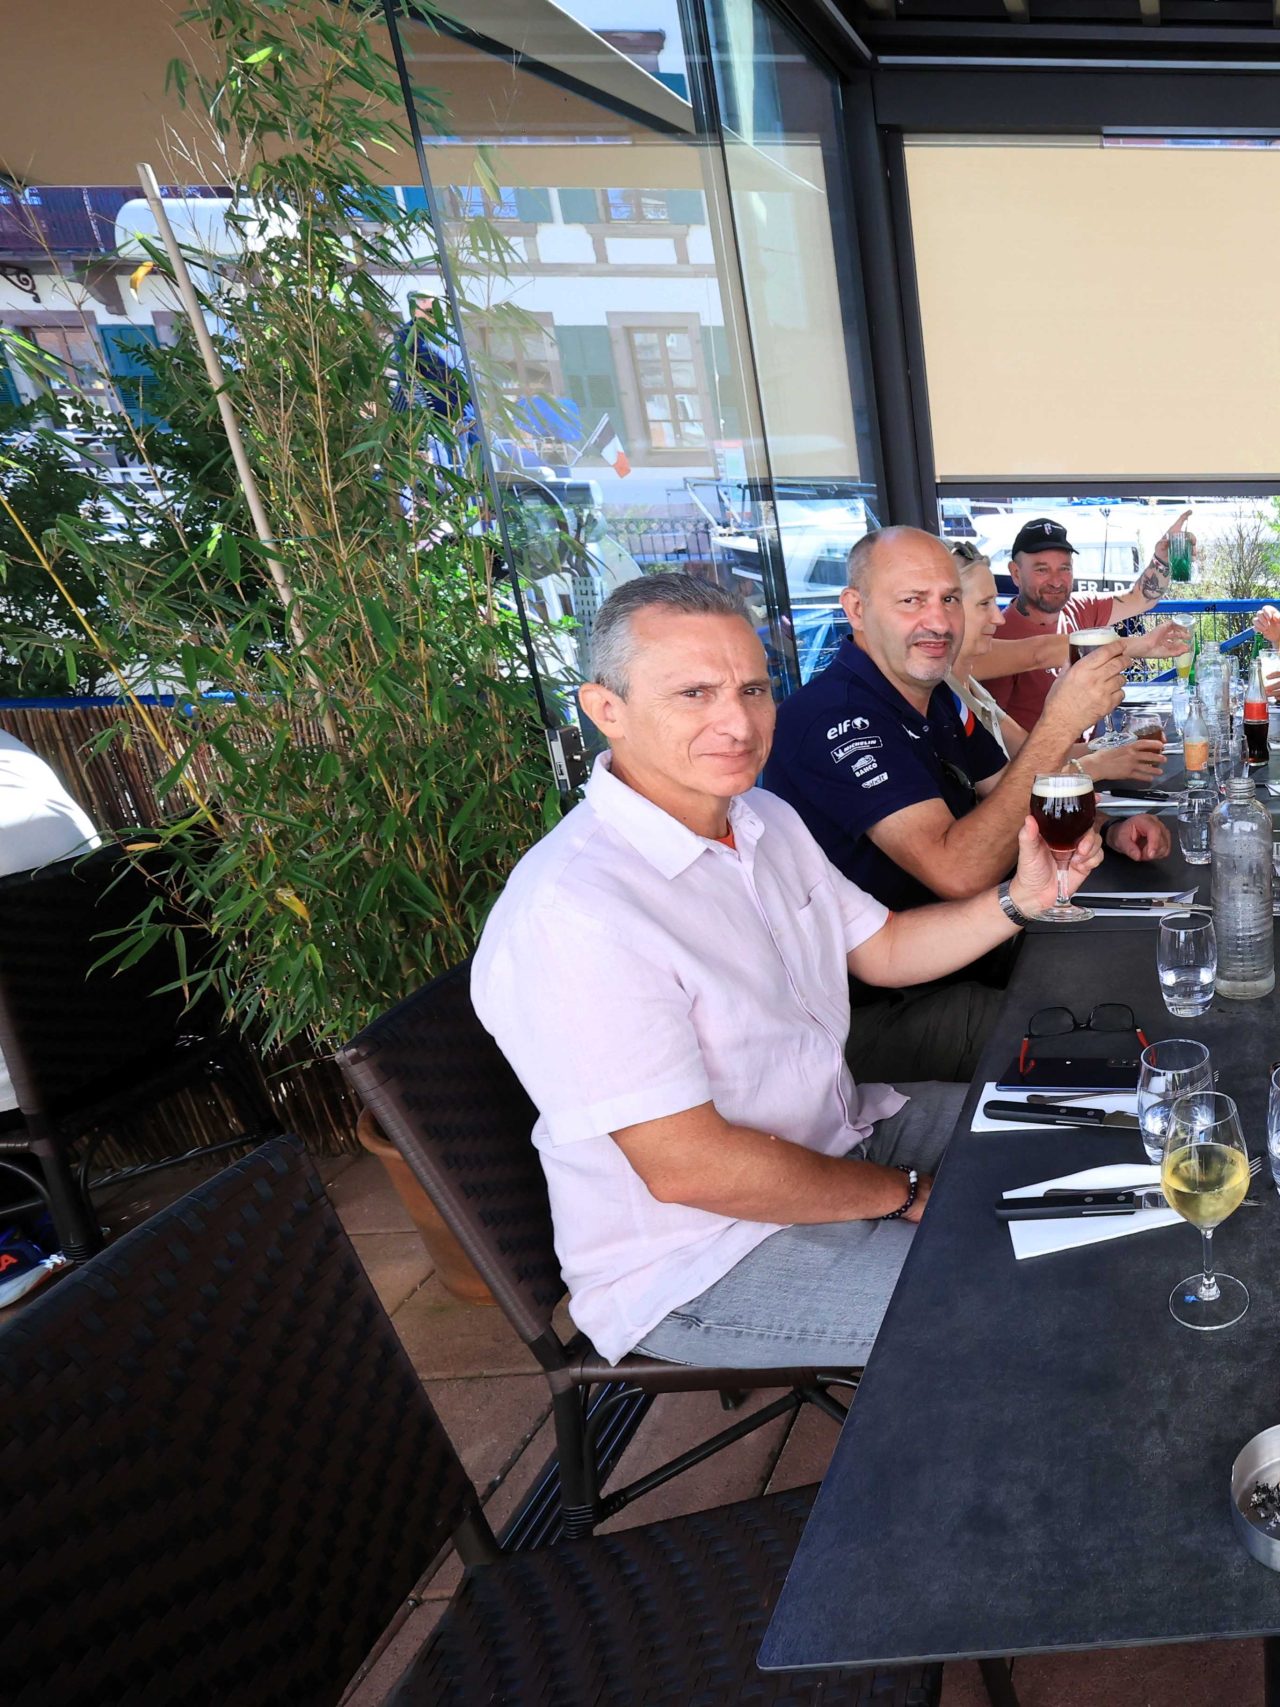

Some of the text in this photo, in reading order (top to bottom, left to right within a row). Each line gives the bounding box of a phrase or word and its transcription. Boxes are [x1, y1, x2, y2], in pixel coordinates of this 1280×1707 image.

[827, 719, 851, 740] elf
[843, 739, 877, 752] MICHELIN
[854, 762, 878, 778] BAHCO
